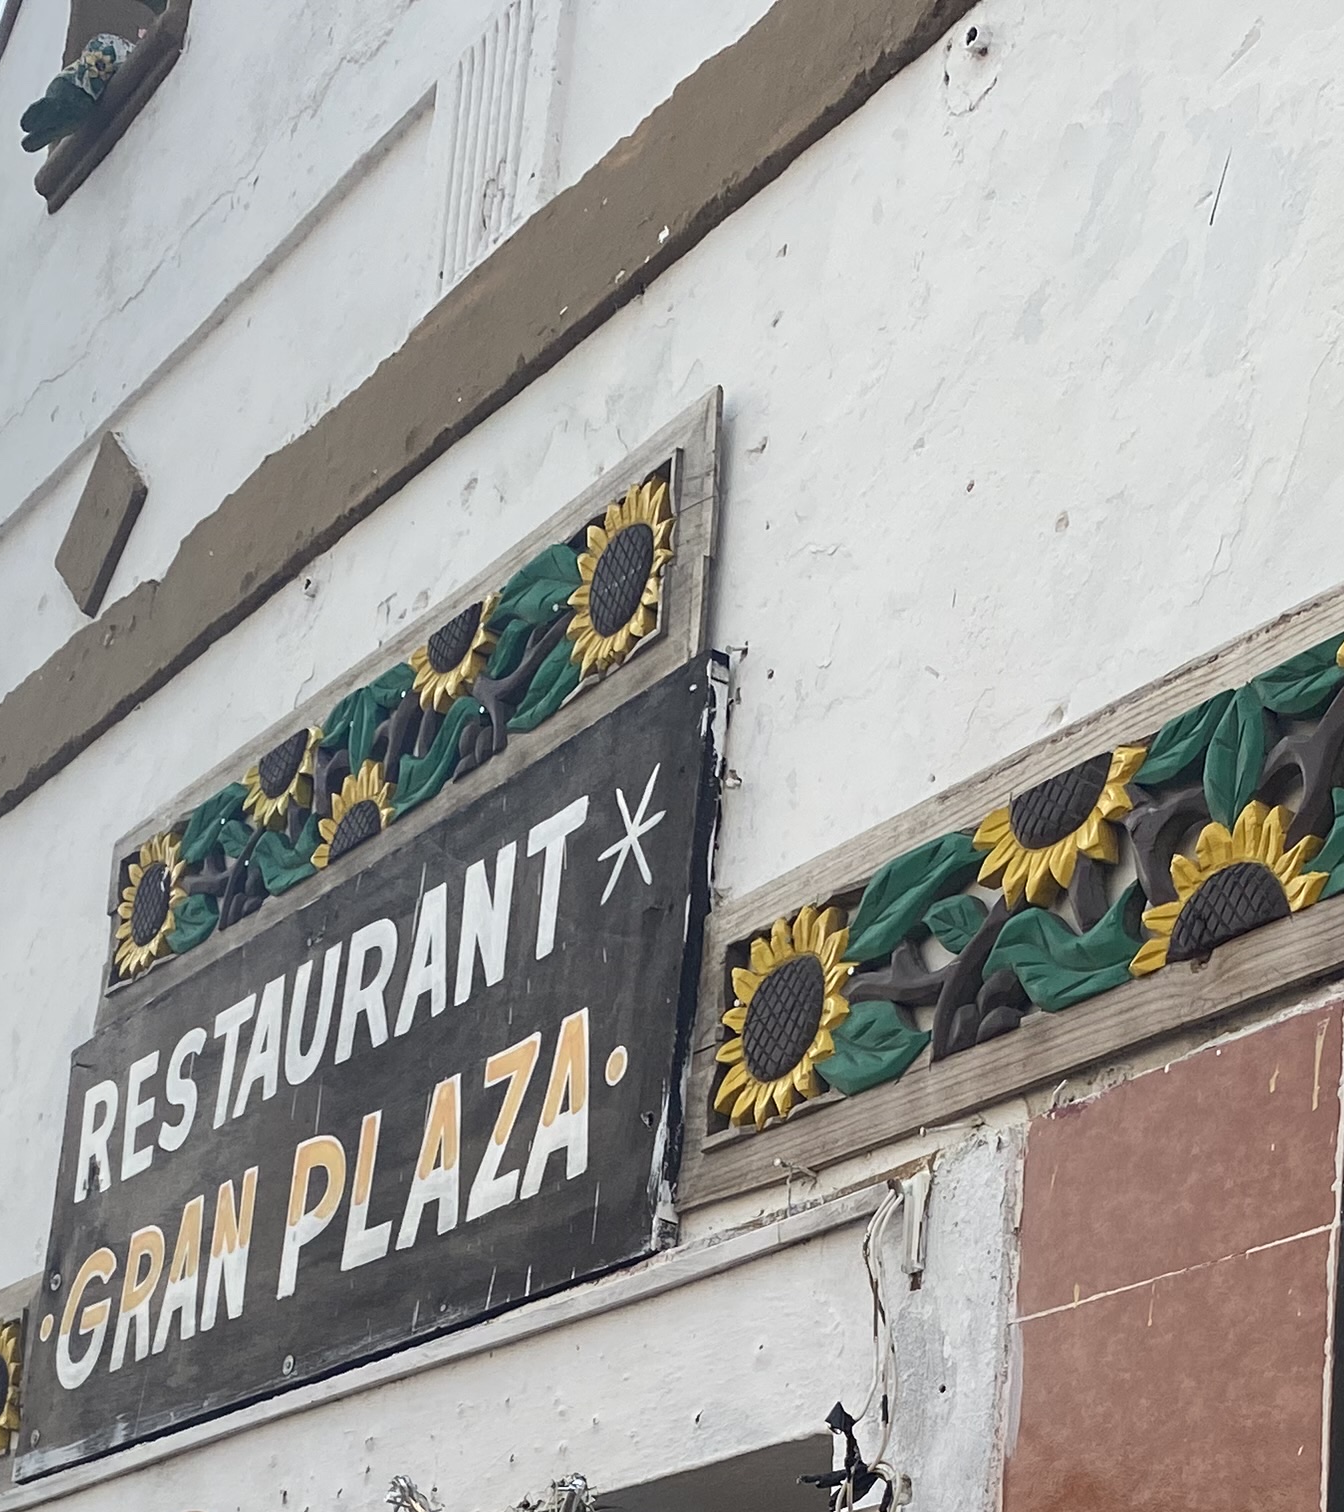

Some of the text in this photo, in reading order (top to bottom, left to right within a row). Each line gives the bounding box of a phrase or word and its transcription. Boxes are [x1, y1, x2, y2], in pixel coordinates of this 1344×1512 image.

[73, 794, 590, 1204] RESTAURANT
[55, 1006, 591, 1390] GRAN PLAZA
